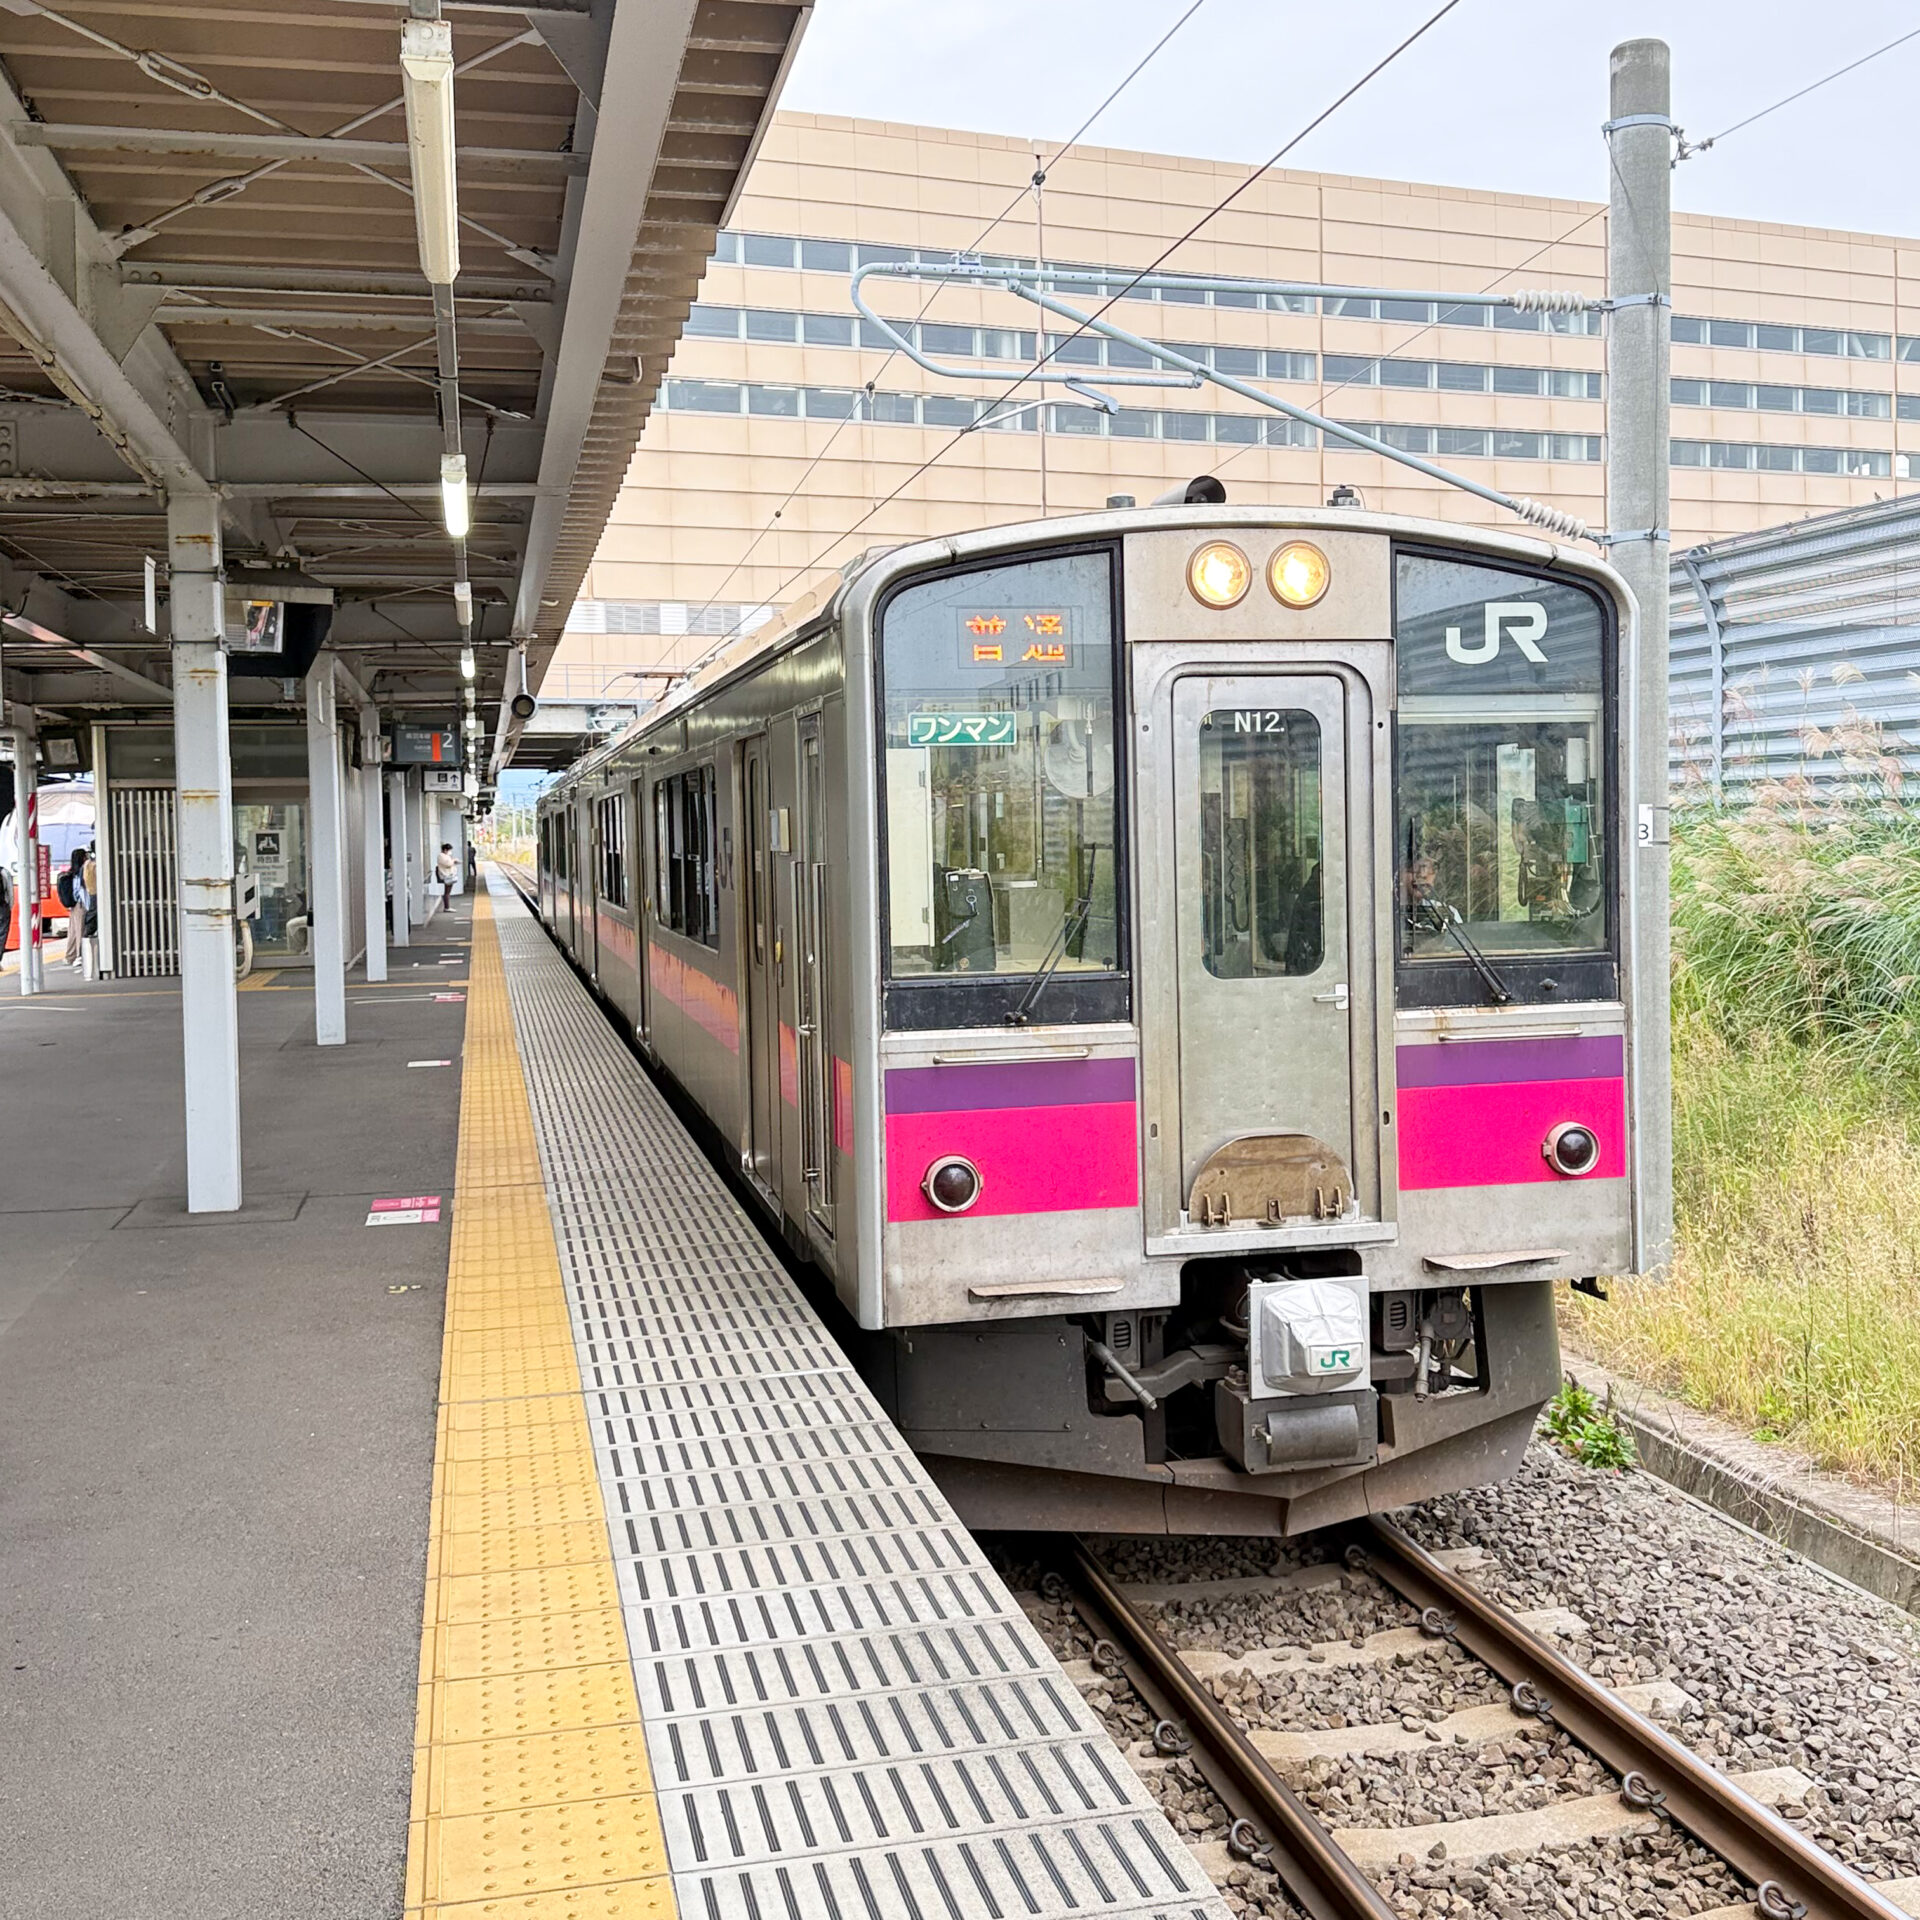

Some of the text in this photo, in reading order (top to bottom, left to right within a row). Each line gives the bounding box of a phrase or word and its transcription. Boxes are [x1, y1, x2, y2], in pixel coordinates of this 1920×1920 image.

[964, 613, 1066, 662] 普通
[1446, 601, 1549, 665] JR
[443, 733, 453, 748] 2
[912, 716, 1012, 743] ワンマン
[1638, 823, 1649, 840] 3
[719, 827, 735, 891] JR
[1320, 1350, 1350, 1369] JR
